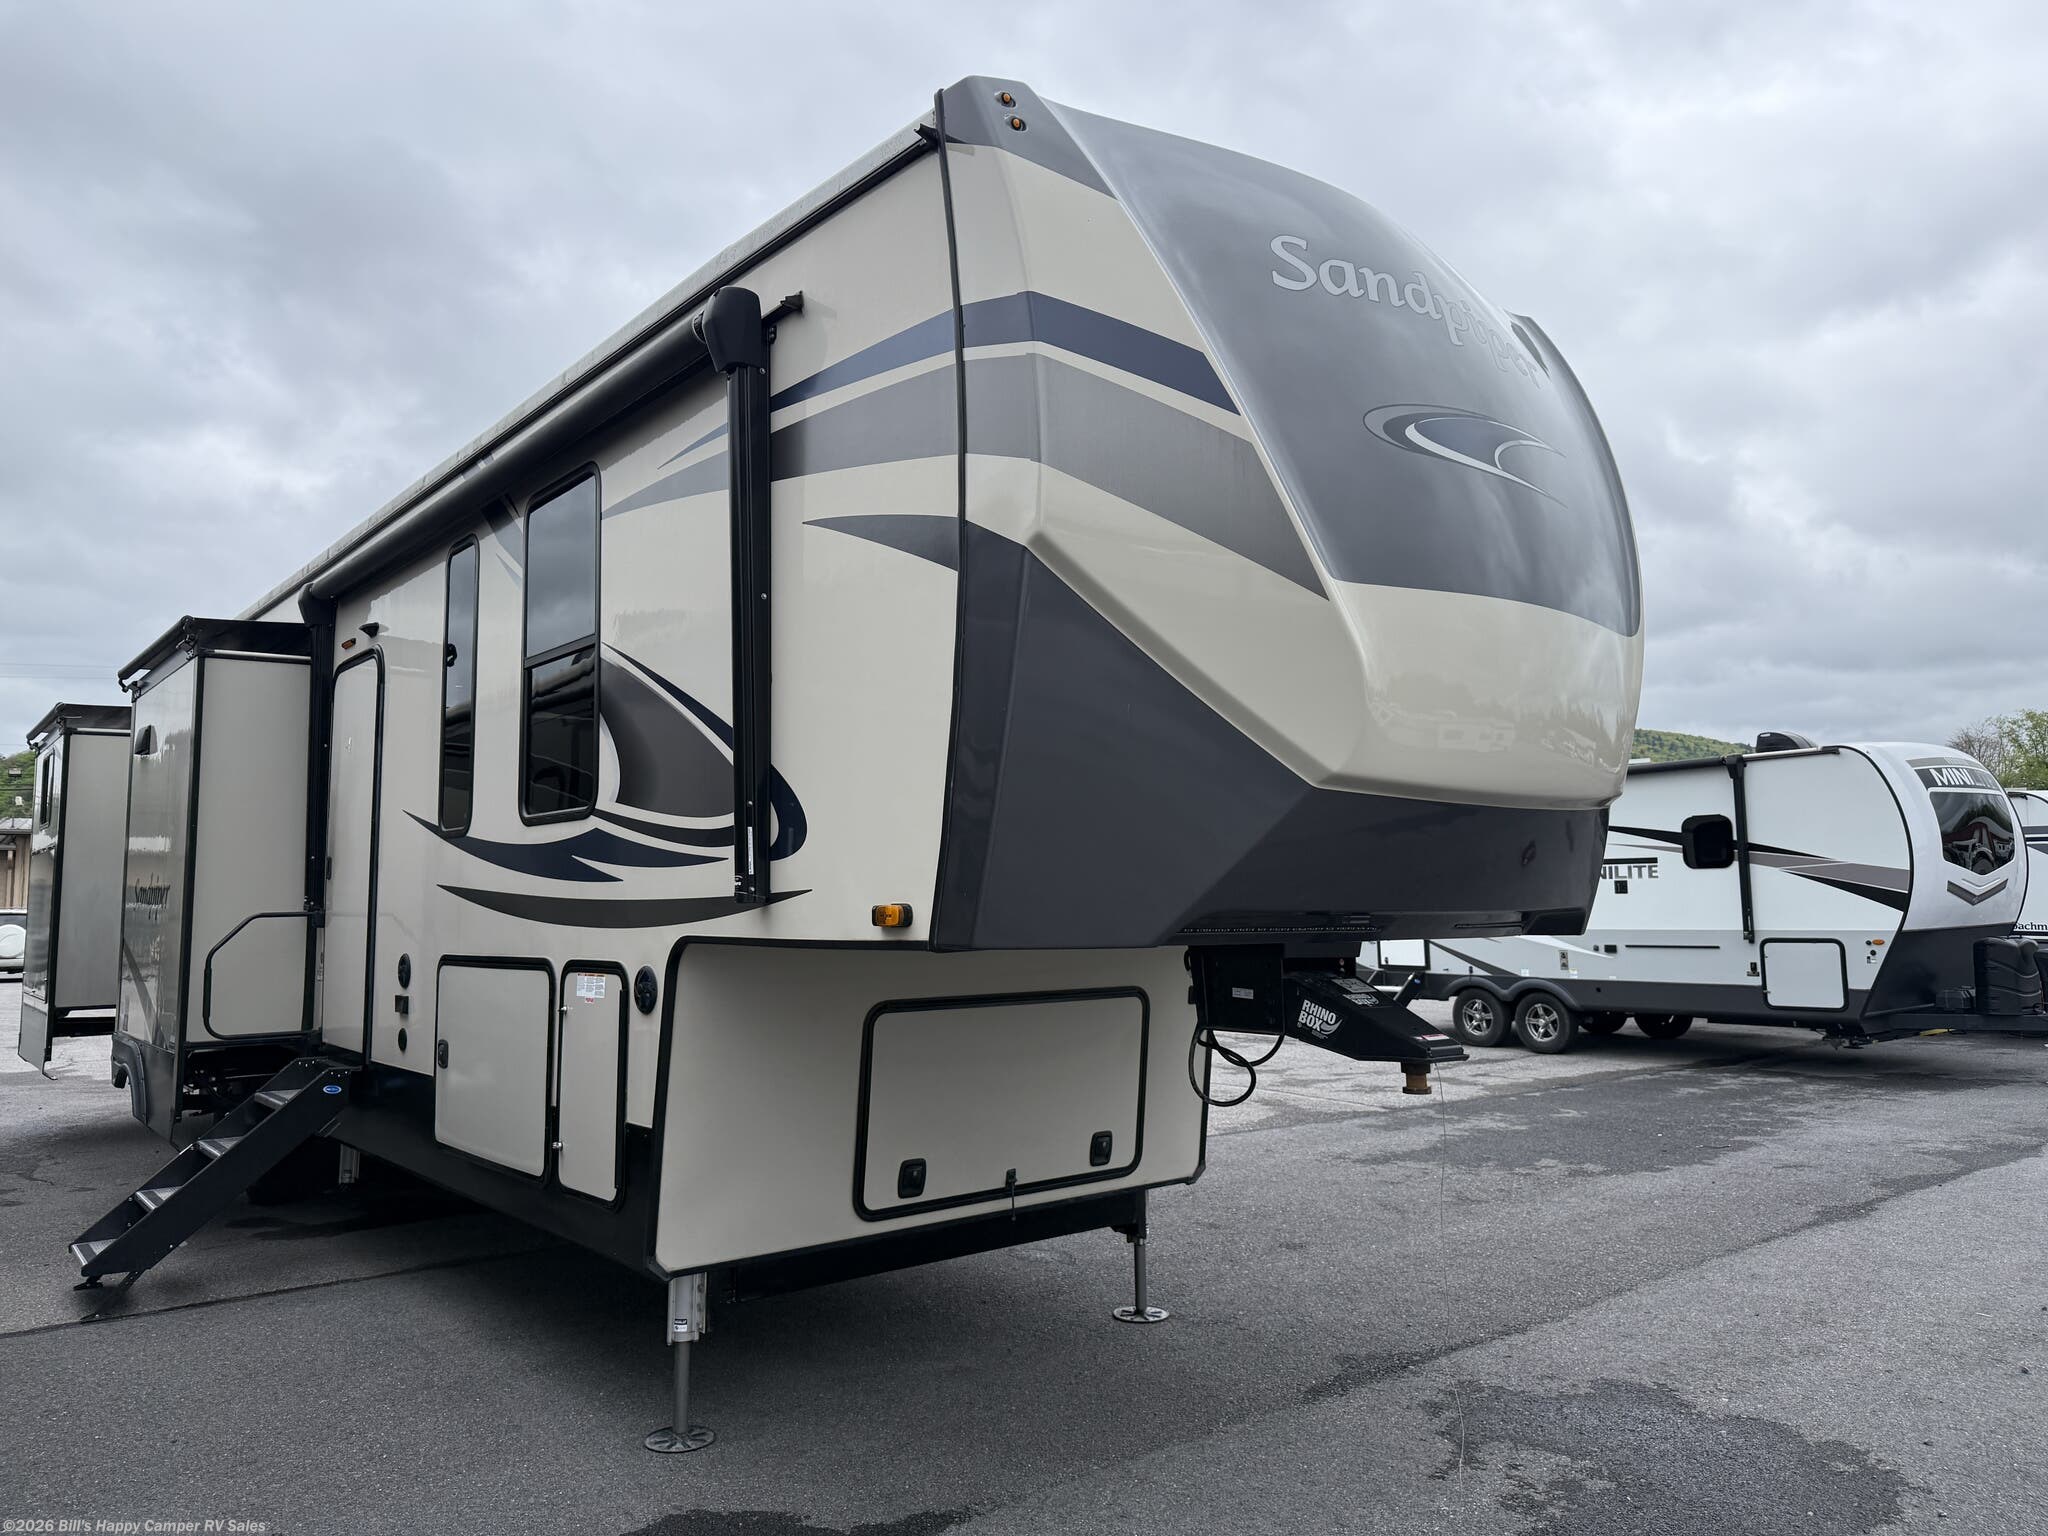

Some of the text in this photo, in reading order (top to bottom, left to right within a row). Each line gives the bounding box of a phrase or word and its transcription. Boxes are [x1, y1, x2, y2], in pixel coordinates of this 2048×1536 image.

[1270, 235, 1542, 389] Sandpiper
[1600, 864, 1659, 879] NILITE
[1298, 1010, 1323, 1032] BOX
[1301, 999, 1337, 1025] RHINO
